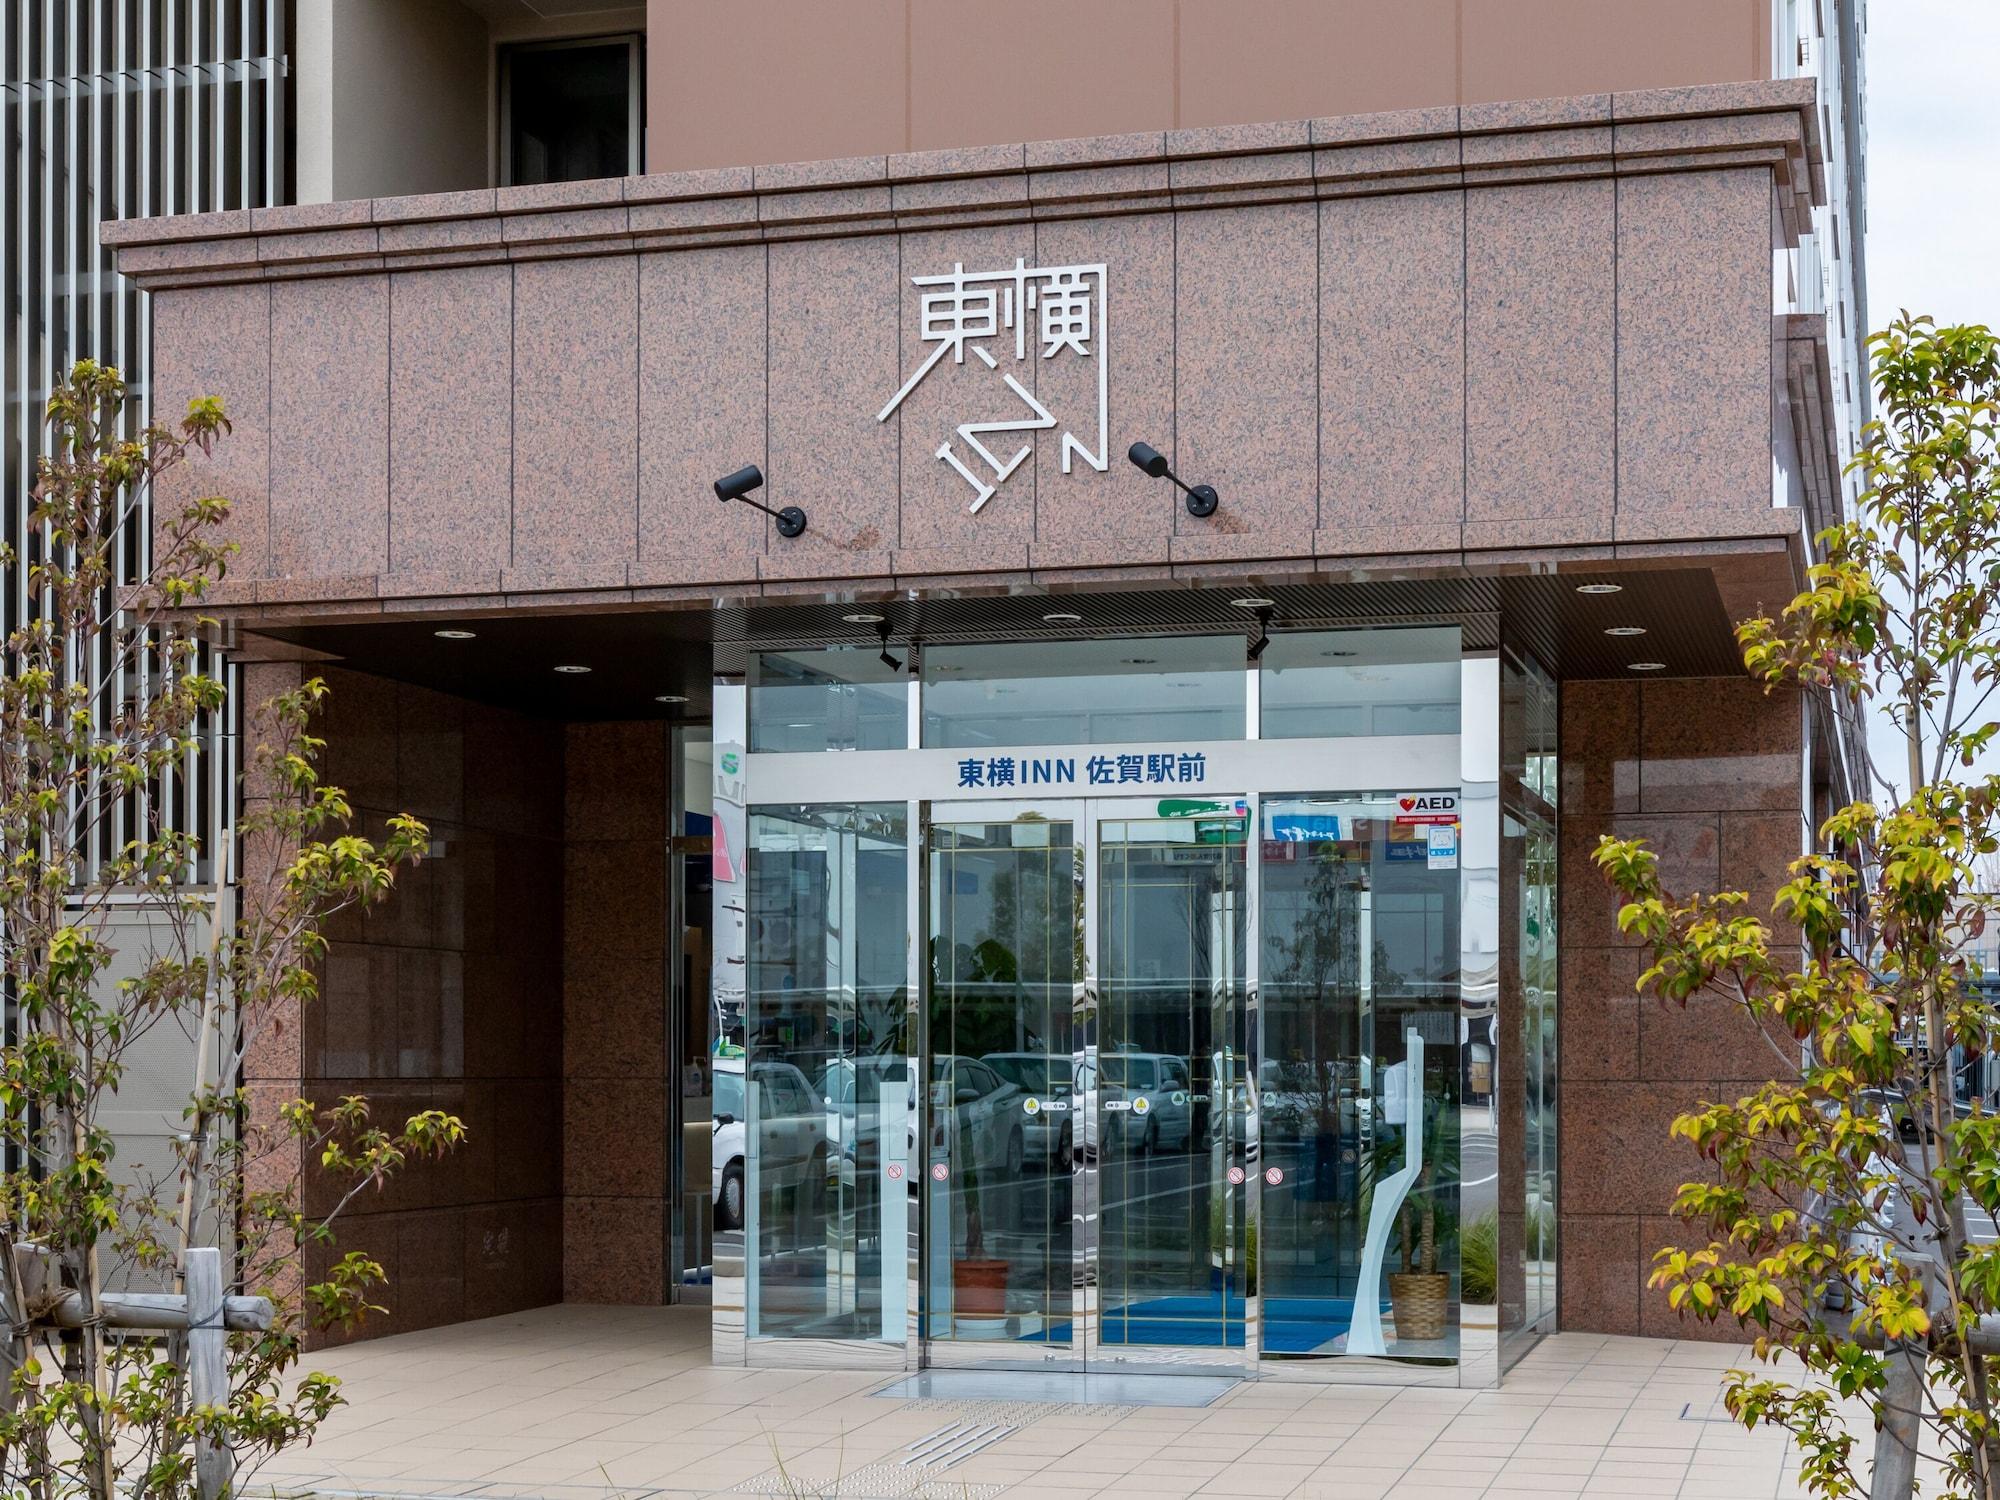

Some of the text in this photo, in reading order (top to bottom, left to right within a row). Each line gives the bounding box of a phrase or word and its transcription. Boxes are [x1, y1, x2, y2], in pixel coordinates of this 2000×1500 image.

[957, 752, 1206, 788] 東横INN 佐賀駅前
[1415, 797, 1455, 810] AED
